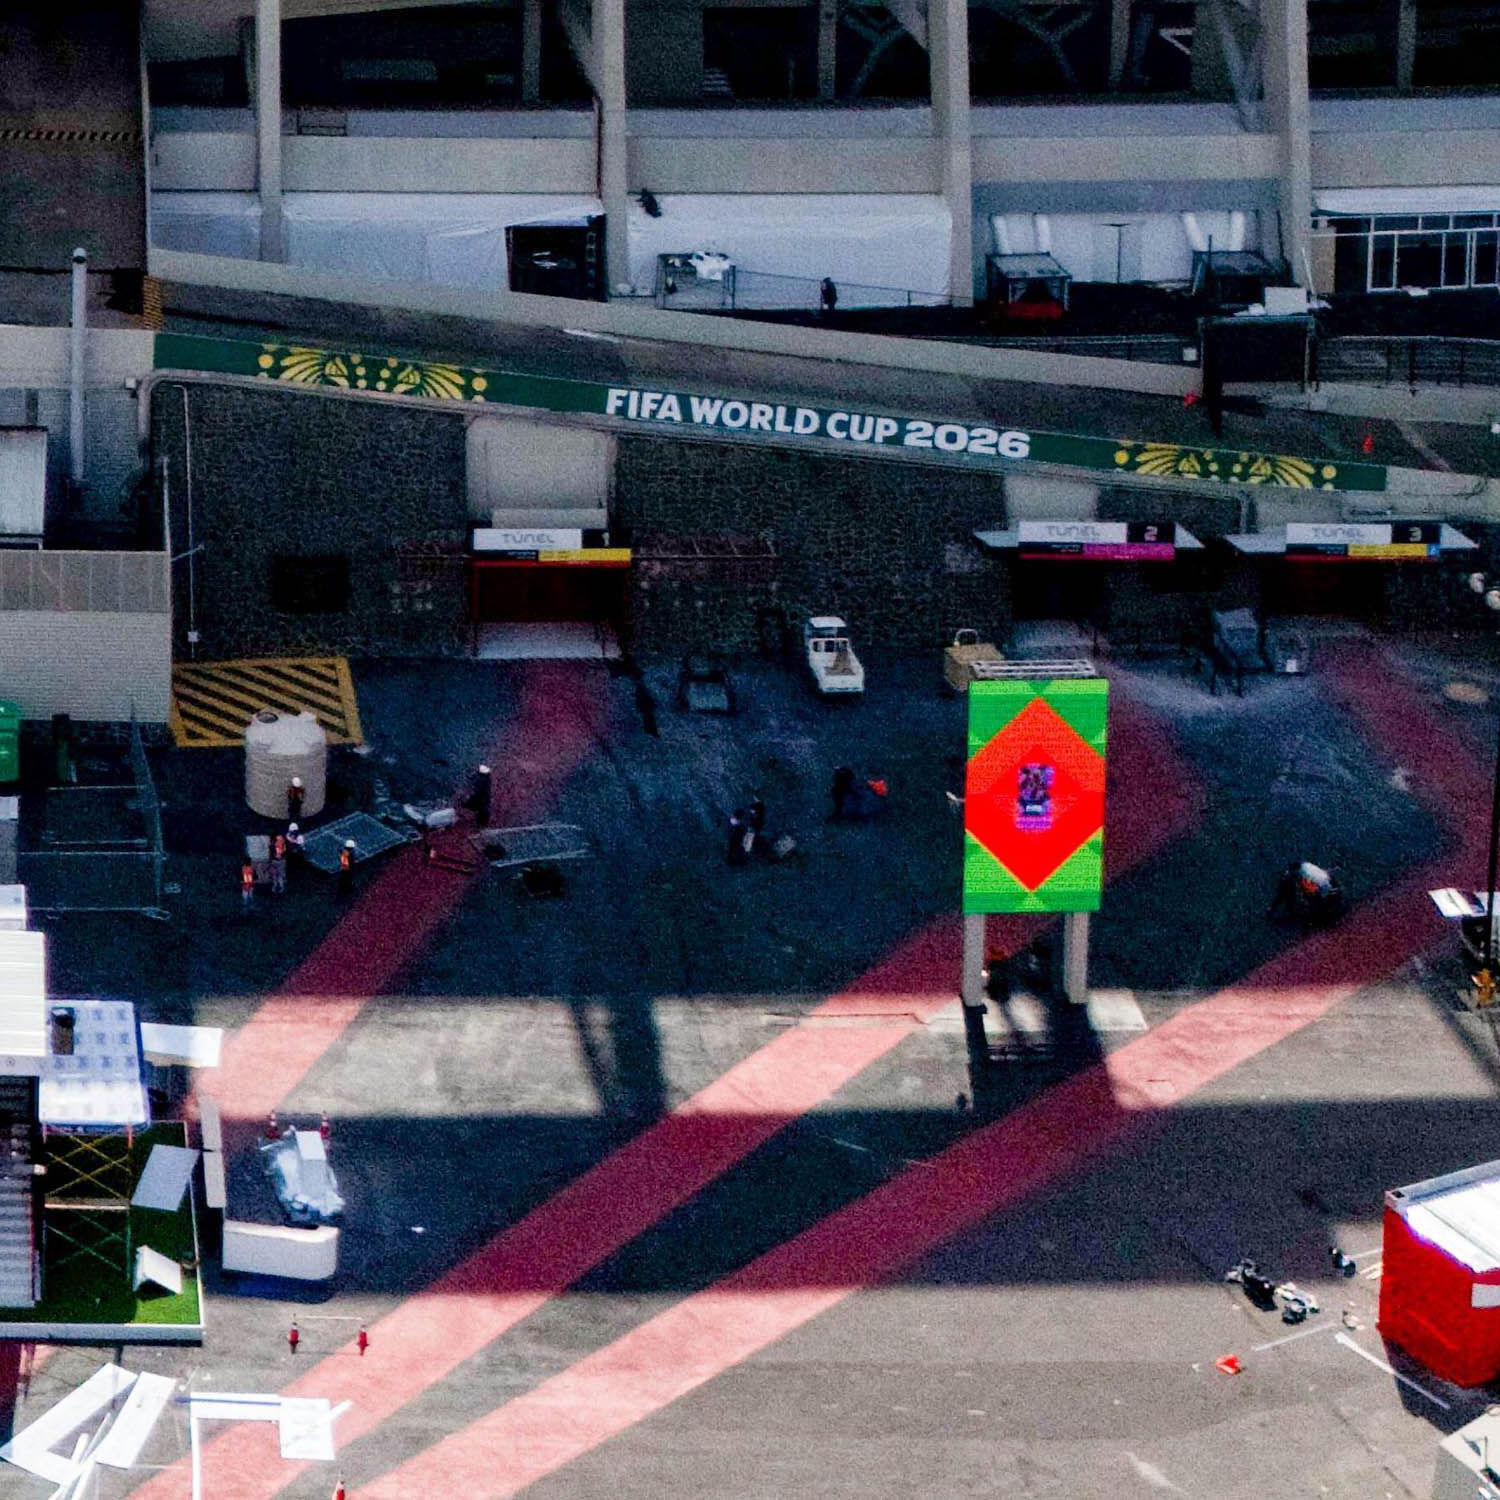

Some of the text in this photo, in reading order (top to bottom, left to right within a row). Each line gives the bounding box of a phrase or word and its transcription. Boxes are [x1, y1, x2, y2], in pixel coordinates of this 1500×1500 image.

[605, 388, 1031, 459] FIFA WORLD CUP 2026
[1408, 526, 1422, 542] 3
